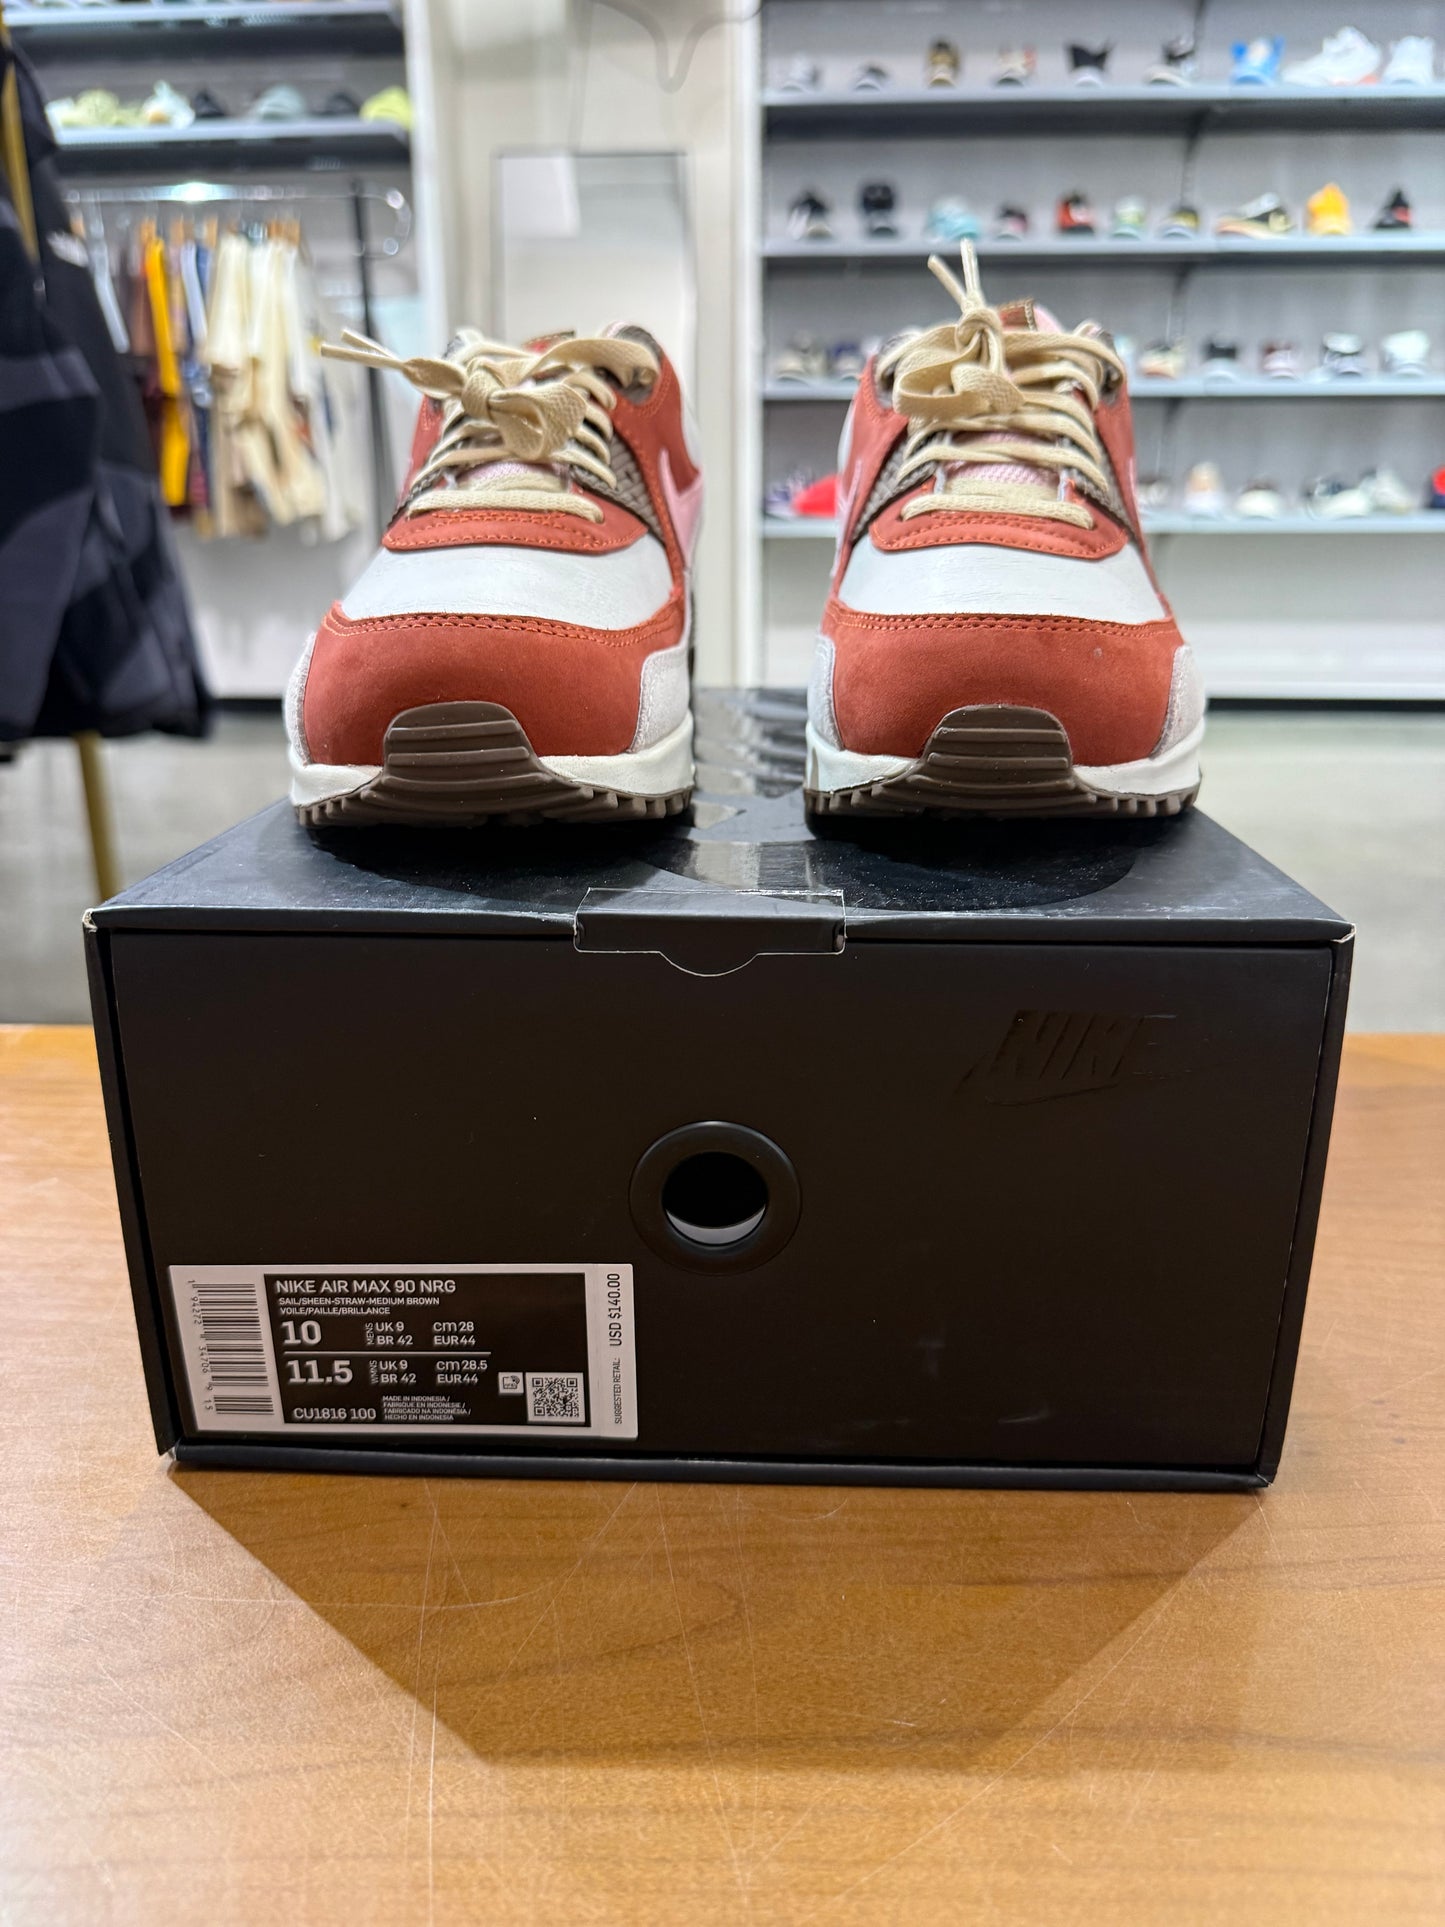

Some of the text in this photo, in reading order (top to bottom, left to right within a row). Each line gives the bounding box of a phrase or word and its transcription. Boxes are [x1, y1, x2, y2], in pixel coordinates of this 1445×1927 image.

[989, 1009, 1177, 1081] NIKE
[275, 1280, 456, 1293] NIKE AIR MAX 90 NRG
[278, 1297, 440, 1306] SAIL/SHEEN-STRAW-MEDIUM BROWN
[279, 1306, 391, 1315] VOILE/PAILLE/BRILLANCE
[281, 1320, 322, 1345] 10
[375, 1321, 405, 1332] UK 9
[191, 1296, 202, 1325] 94272
[199, 1346, 209, 1374] 34706
[376, 1335, 413, 1345] BR 42
[607, 1273, 623, 1425] SUGGESTED RETAIL: USD $140.00
[286, 1359, 353, 1383] 11.5
[379, 1359, 408, 1371] UK 9
[380, 1373, 417, 1384] BR 42
[293, 1407, 376, 1420] CU1816 100
